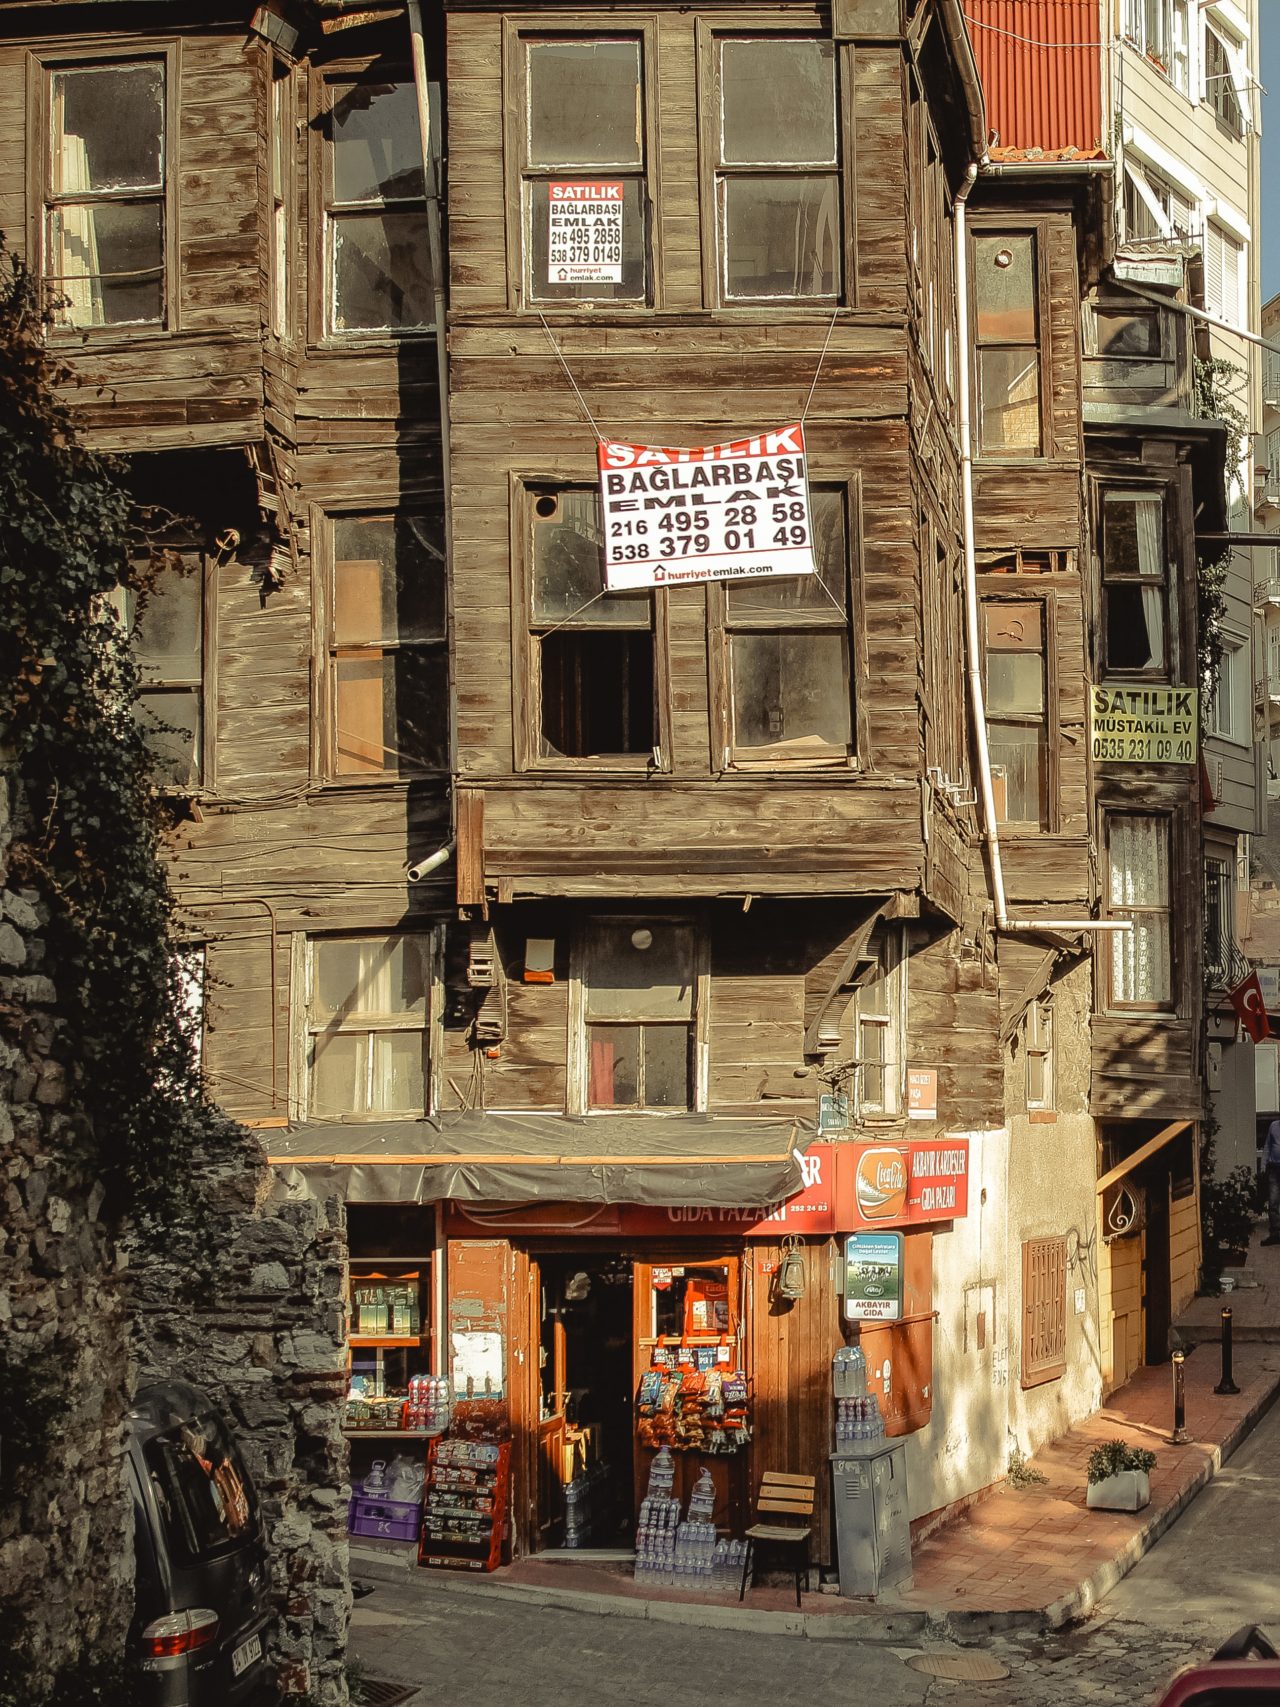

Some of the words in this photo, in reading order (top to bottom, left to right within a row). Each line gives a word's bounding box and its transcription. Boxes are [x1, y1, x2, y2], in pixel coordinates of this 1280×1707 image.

[552, 186, 620, 198] SATILIK
[551, 202, 621, 216] BAĞLARBAŞI
[551, 218, 620, 227] EMLAK
[551, 232, 568, 245] 216
[569, 228, 590, 245] 495
[593, 228, 620, 245] 2858
[551, 249, 567, 262] 538
[569, 246, 590, 262] 379
[593, 246, 620, 262] 0149
[607, 458, 804, 495] BAĞLARBAŞI
[609, 485, 804, 513] EMLAK
[611, 520, 648, 537] 216
[658, 510, 710, 532] 495
[724, 505, 757, 527] 28
[772, 502, 806, 523] 58
[612, 543, 649, 561] 538
[660, 534, 710, 557] 379
[724, 528, 755, 550] 01
[773, 526, 806, 546] 49
[1094, 690, 1192, 716] SATILIK
[1094, 717, 1168, 734] MÜSTAKİL
[1173, 722, 1192, 734] EV
[1094, 738, 1124, 759] 0535
[1129, 739, 1151, 760] 231
[1157, 740, 1172, 760] 09
[1176, 740, 1192, 761] 40
[912, 1151, 935, 1177] AKBAYIR
[936, 1150, 966, 1183] KARDEŞLER
[922, 1187, 935, 1210] GIDA
[936, 1186, 956, 1209] PAZARI
[667, 1206, 713, 1222] GIDA
[855, 1301, 891, 1309] AKBAYIR
[863, 1309, 883, 1317] GIDA
